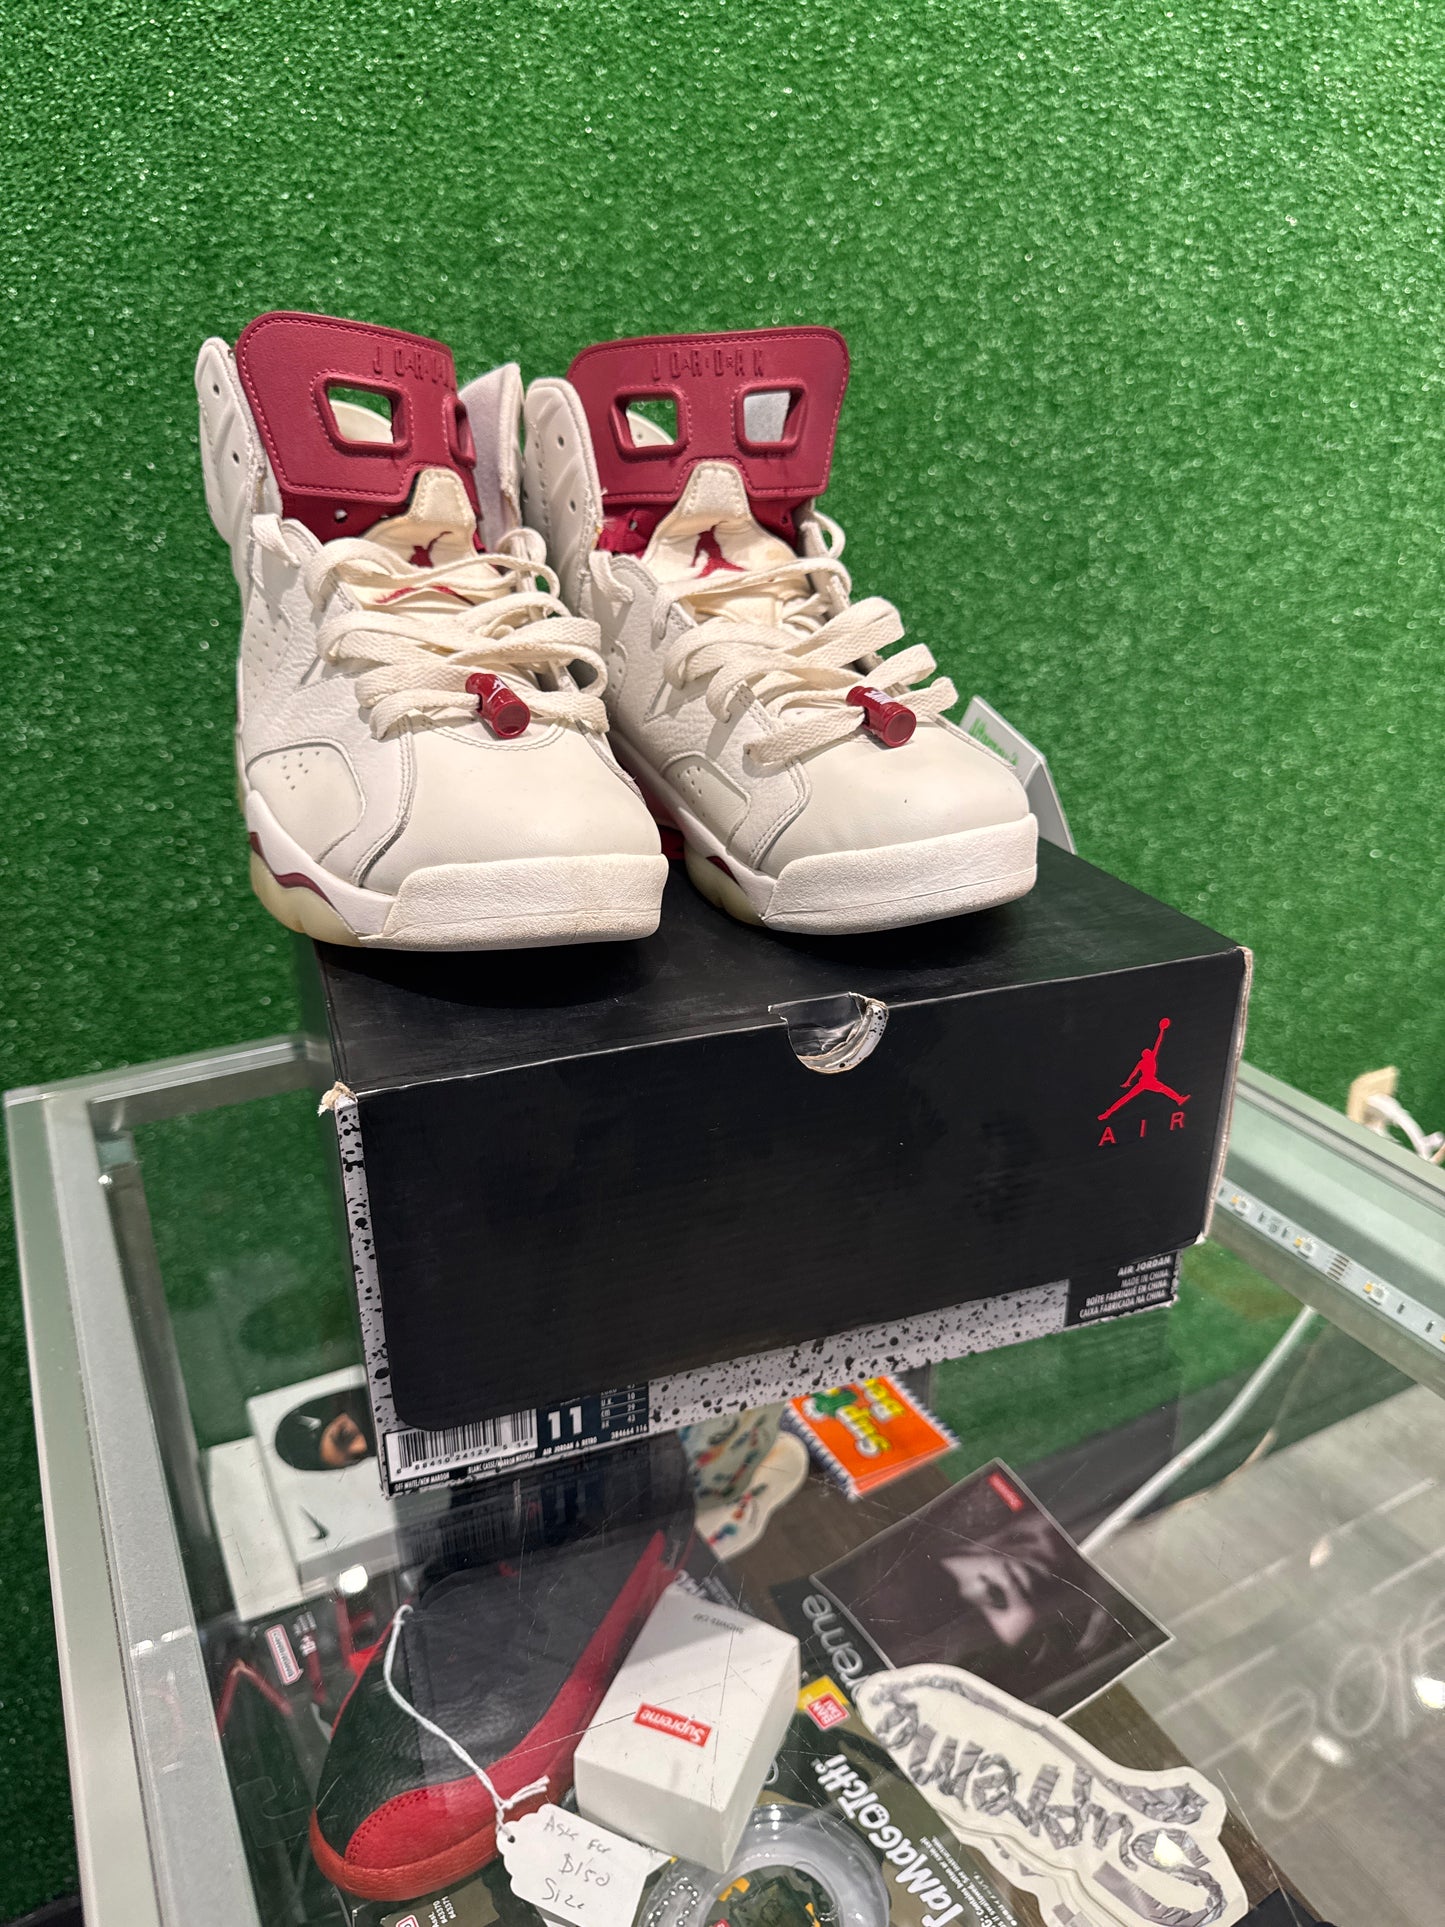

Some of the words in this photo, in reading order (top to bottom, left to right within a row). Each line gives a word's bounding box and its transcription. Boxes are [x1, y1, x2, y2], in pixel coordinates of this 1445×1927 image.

[1098, 1111, 1185, 1147] AIR
[1118, 1264, 1134, 1276] AIR
[1135, 1256, 1171, 1272] JORDAN
[1121, 1277, 1139, 1287] MADE
[1141, 1274, 1148, 1283] IN
[1149, 1269, 1169, 1281] CHINA
[1138, 1285, 1147, 1293] EN
[1148, 1279, 1168, 1291] CHINA
[1079, 1306, 1099, 1318] CAIXA
[1100, 1298, 1134, 1313] FABRICADA
[1136, 1295, 1145, 1304] NA
[1146, 1290, 1166, 1302] CHINA
[626, 1391, 636, 1401] 10
[627, 1403, 636, 1411] 29
[547, 1406, 586, 1441] 11
[626, 1414, 636, 1423] 43
[610, 1427, 634, 1440] 384664
[454, 1447, 491, 1462] 24129
[542, 1447, 553, 1456] AIR
[553, 1442, 574, 1453] JORDAN
[580, 1436, 598, 1447] RETRO
[467, 1464, 482, 1474] BLANC
[515, 1450, 536, 1463] NOUVEAU
[394, 1482, 405, 1491] OFF
[404, 1476, 430, 1489] WHITE/NEW
[430, 1471, 450, 1482] MAROON
[808, 1698, 837, 1727] BAN
[823, 1698, 845, 1720] DAI
[639, 1709, 705, 1744] Supreme
[938, 1860, 949, 1869] or
[944, 1867, 965, 1889] button
[957, 1870, 971, 1884] See
[960, 1887, 985, 1916] Contains
[965, 1882, 996, 1917] swallowed.
[991, 1914, 1000, 1923] if
